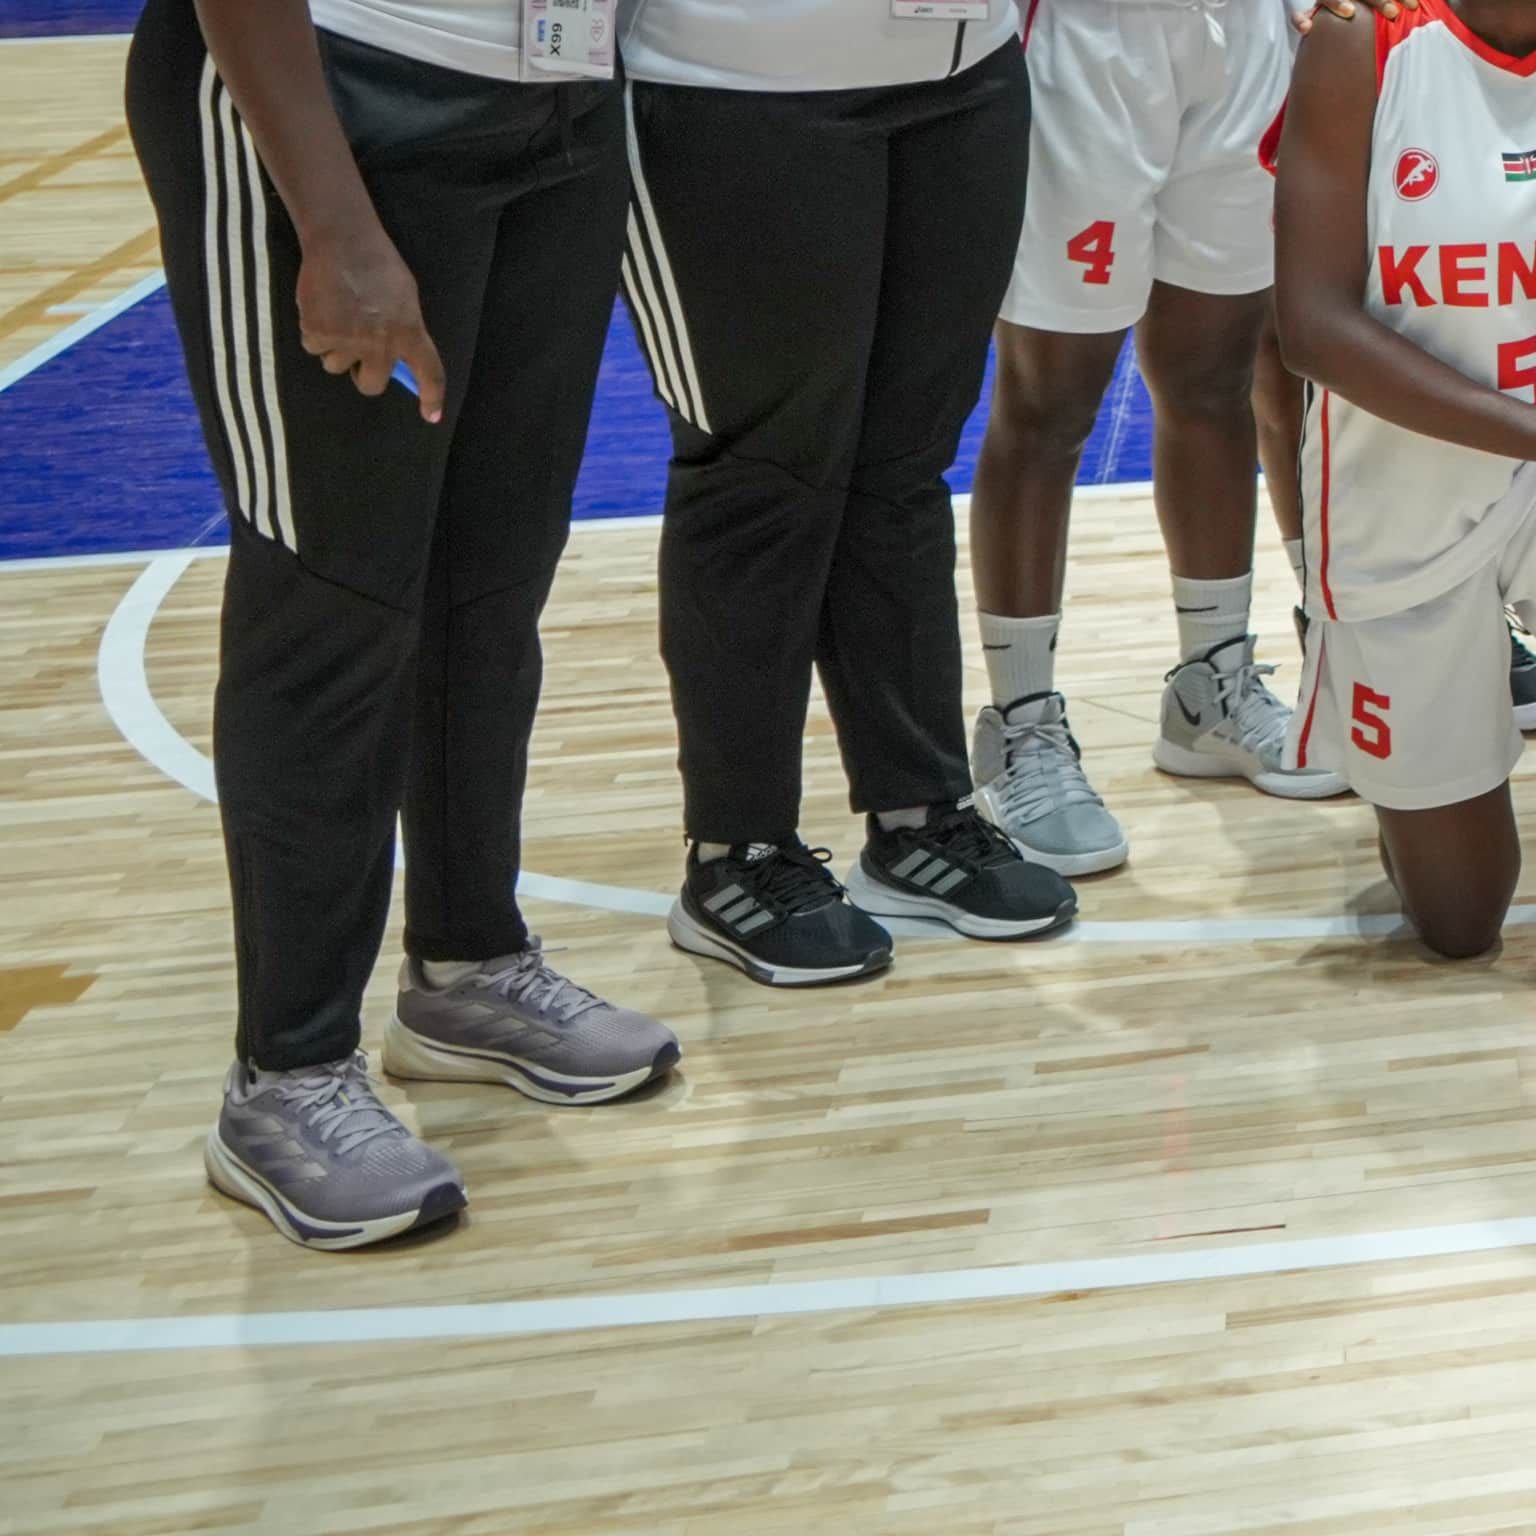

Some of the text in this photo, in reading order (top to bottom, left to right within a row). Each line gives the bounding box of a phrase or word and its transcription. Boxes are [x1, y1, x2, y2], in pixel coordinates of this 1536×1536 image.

[550, 22, 563, 56] X99
[1067, 220, 1116, 285] 4
[1350, 682, 1392, 760] 5
